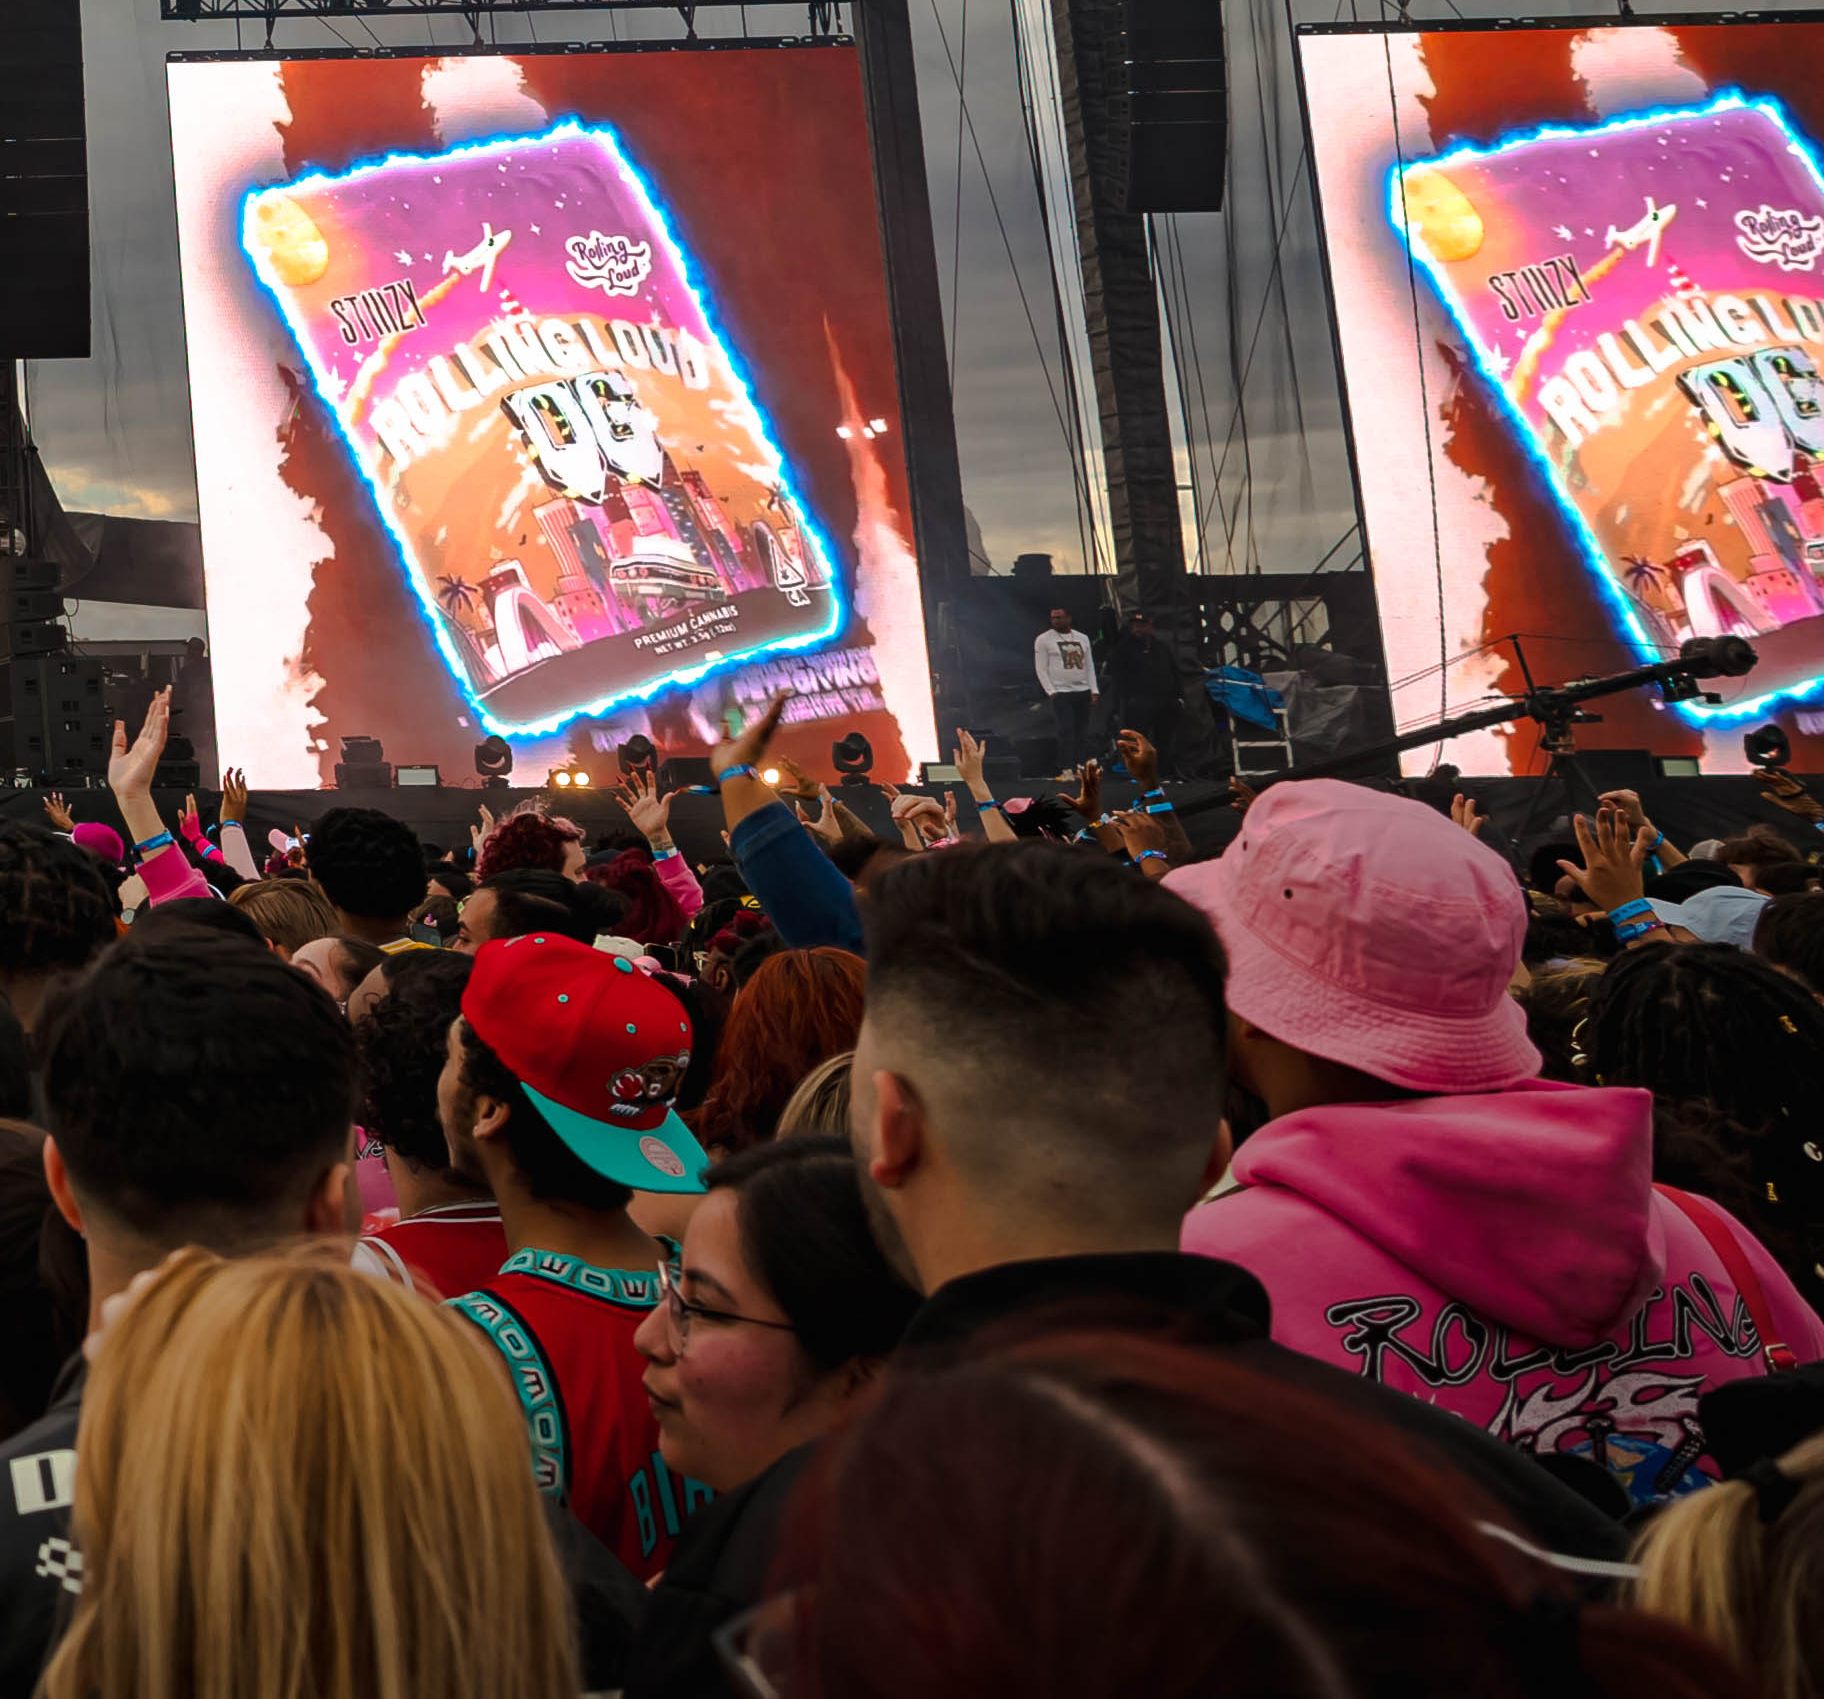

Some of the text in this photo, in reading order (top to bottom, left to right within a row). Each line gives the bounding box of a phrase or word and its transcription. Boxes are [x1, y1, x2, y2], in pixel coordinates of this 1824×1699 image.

[567, 260, 640, 290] Loud
[571, 236, 645, 270] Rolling
[330, 281, 426, 345] STIIIZY
[1488, 255, 1591, 320] STIIIZY
[369, 317, 710, 469] ROLLING LOUD
[1538, 294, 1767, 450] ROLLING
[634, 605, 739, 649] PREMIUM CANNABIS
[654, 641, 672, 655] NET
